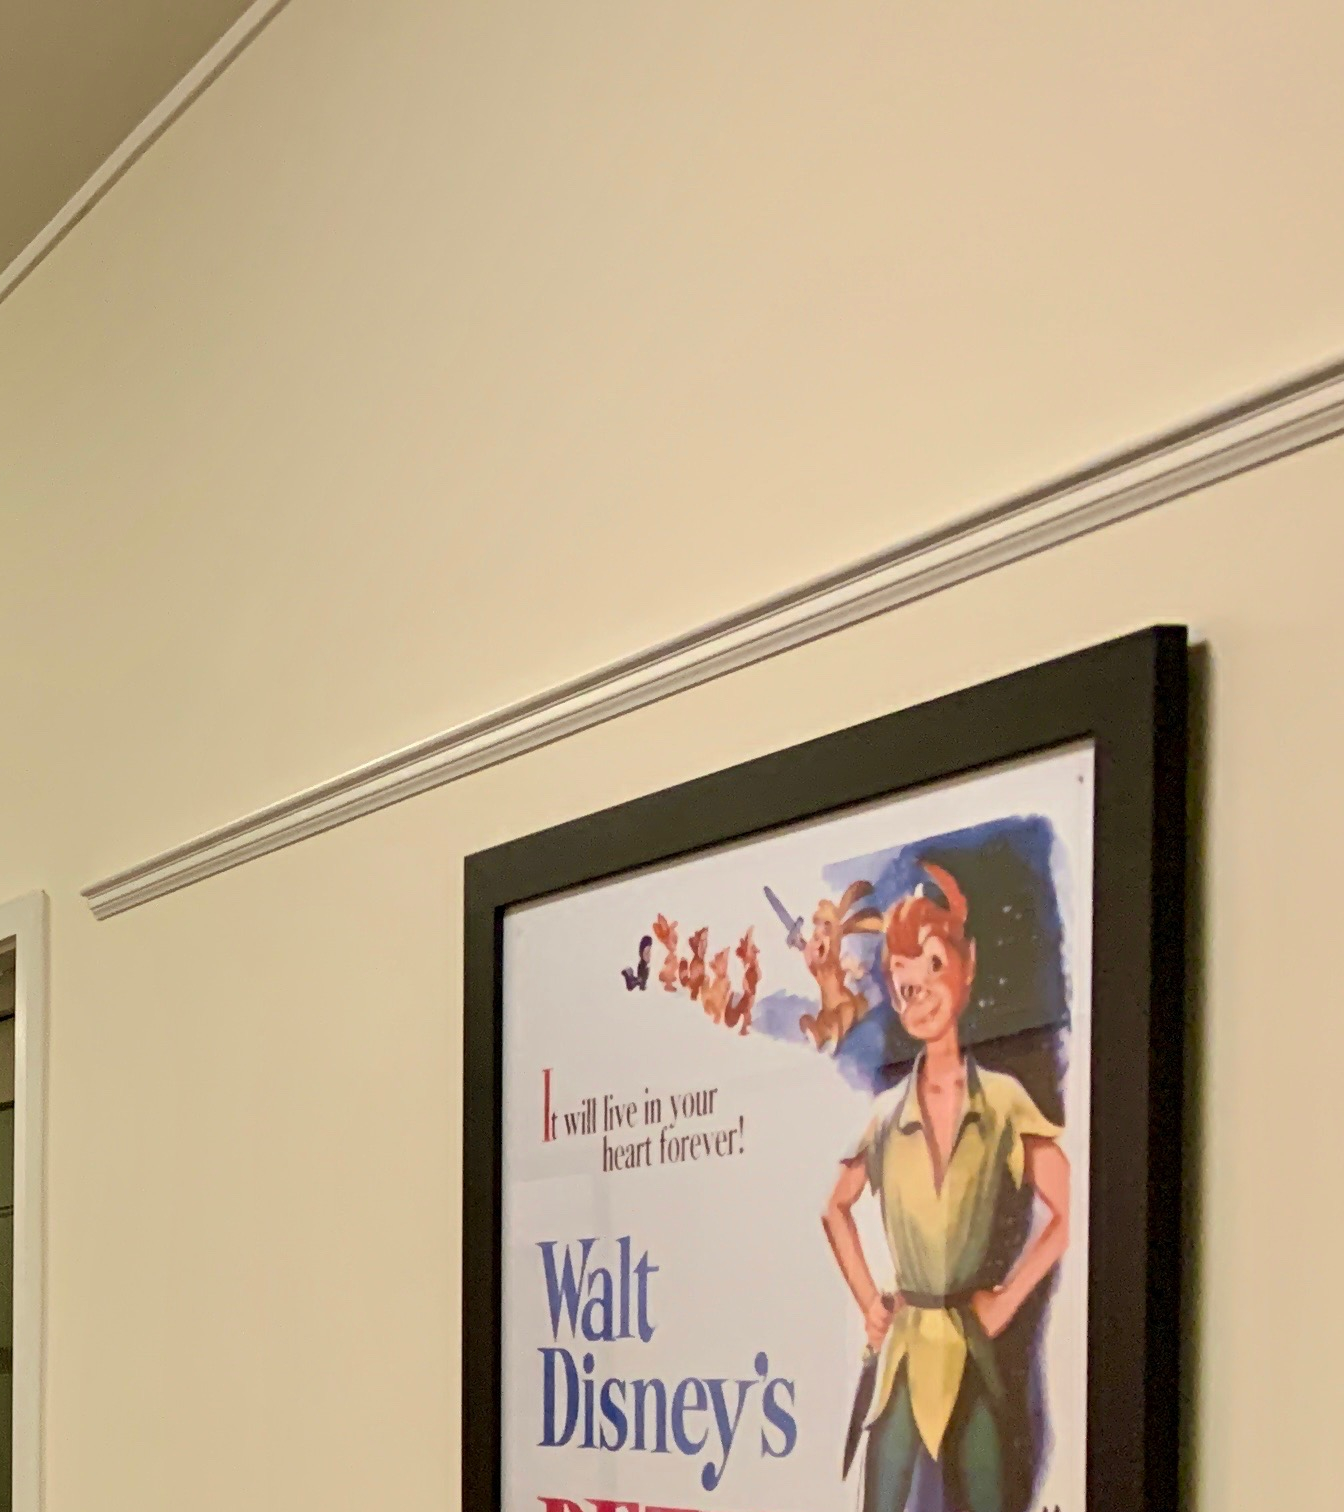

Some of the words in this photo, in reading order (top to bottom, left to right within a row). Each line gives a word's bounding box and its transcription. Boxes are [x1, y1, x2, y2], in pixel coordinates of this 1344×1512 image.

[542, 1068, 558, 1143] It
[564, 1098, 597, 1136] will
[603, 1094, 639, 1132] live
[644, 1088, 662, 1124] in
[669, 1087, 718, 1129] your
[602, 1135, 652, 1172] heart
[659, 1115, 746, 1165] forever!
[535, 1235, 660, 1344] Walt
[536, 1347, 798, 1492] Disney's
